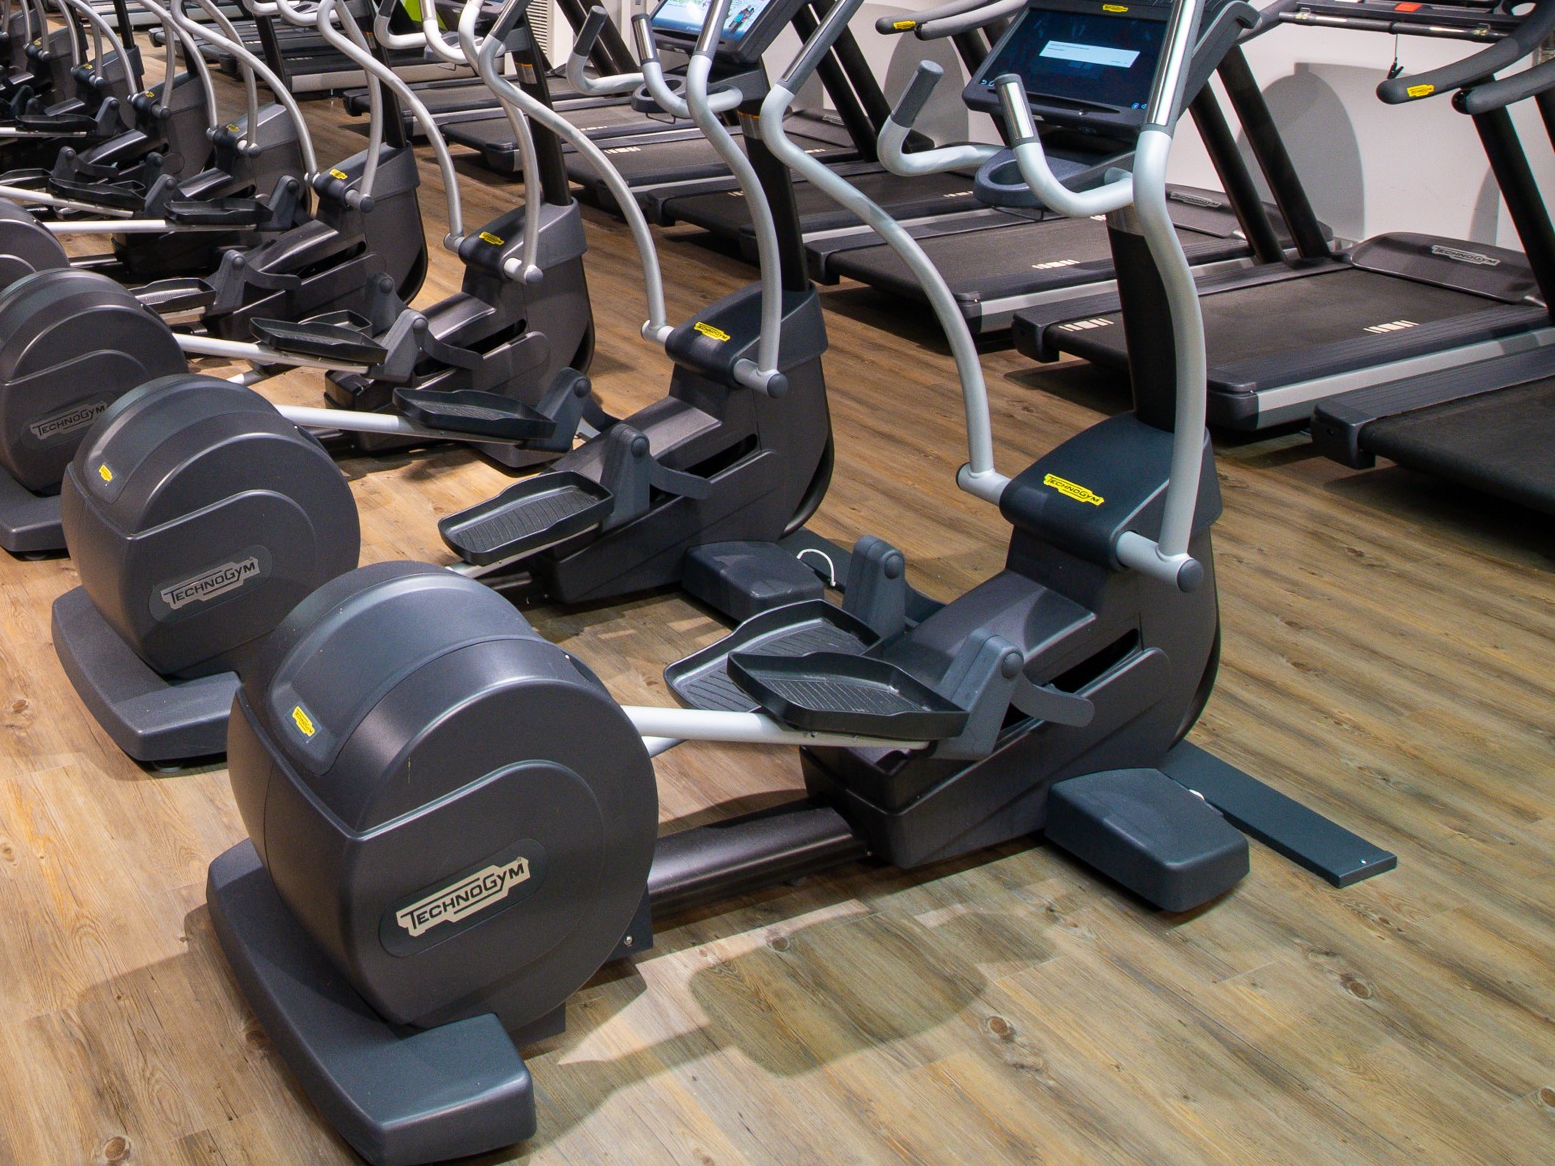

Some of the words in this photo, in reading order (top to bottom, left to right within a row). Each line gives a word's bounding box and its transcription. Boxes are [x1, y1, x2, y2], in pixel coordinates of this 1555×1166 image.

[33, 405, 105, 436] TECHNOGYM
[1046, 475, 1101, 503] TECHNOGYM
[163, 561, 256, 605] TECHNOGYM
[400, 862, 526, 930] TECHNOGYM
